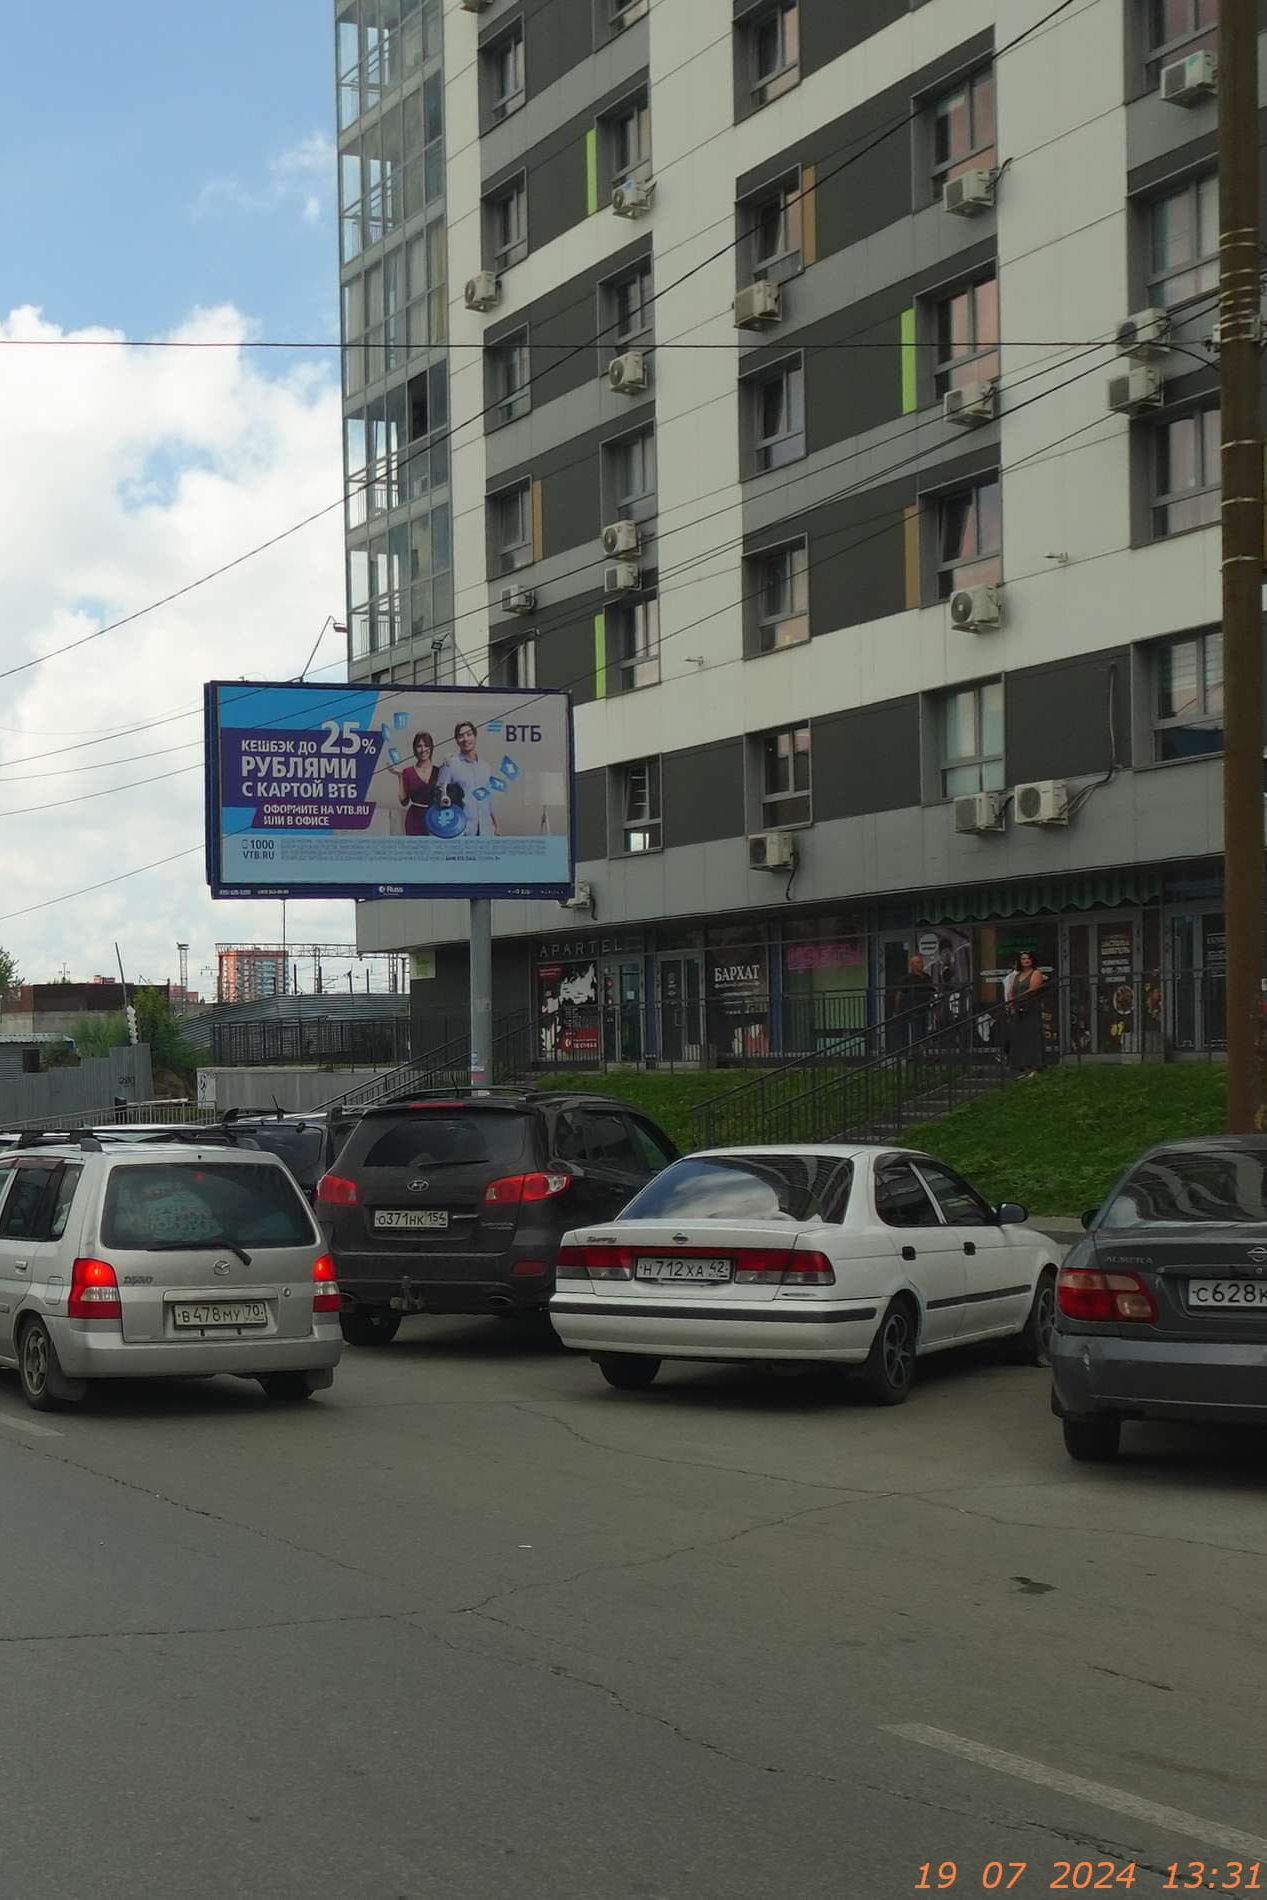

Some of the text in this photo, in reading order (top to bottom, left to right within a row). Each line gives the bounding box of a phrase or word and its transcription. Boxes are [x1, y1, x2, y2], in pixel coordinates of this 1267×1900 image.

[241, 720, 376, 755] КЕШБЭК ДО 25%
[505, 725, 543, 743] ВТБ
[241, 755, 357, 779] РУБЛЯМИ
[242, 780, 358, 798] С КАРТОЙ ВТБ
[263, 804, 370, 815] ОФОРМИТЕ НА VTB.RU
[263, 815, 330, 826] ИЛИ В ОФИСЕ
[251, 839, 275, 850] 1000
[242, 851, 275, 860] VTB.RU
[539, 938, 622, 958] APARTEL
[714, 965, 760, 982] БАРХАТ
[377, 1211, 424, 1226] О371НК
[643, 1259, 725, 1278] Н712ХА 42
[181, 1304, 261, 1323] В478МУ 70
